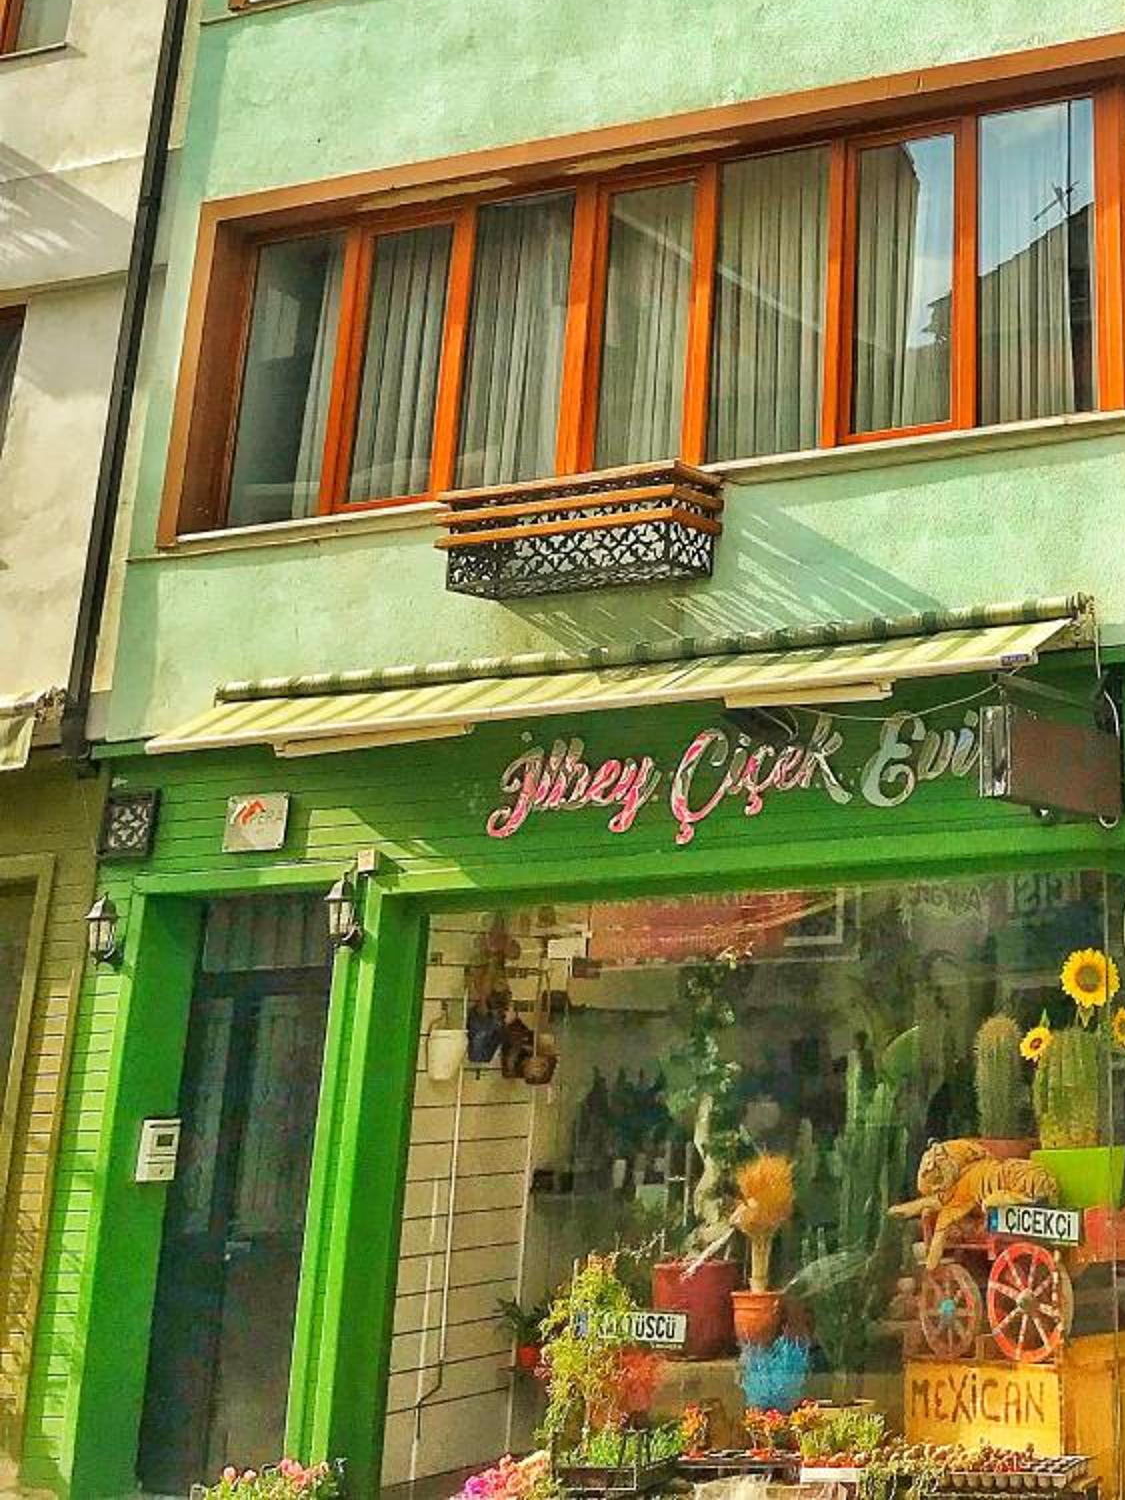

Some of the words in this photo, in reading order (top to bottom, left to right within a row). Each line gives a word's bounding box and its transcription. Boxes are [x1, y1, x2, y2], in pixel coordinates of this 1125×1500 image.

[669, 714, 853, 845] Çiçek
[861, 711, 981, 807] Evi
[599, 1314, 676, 1340] TÜSCÜ
